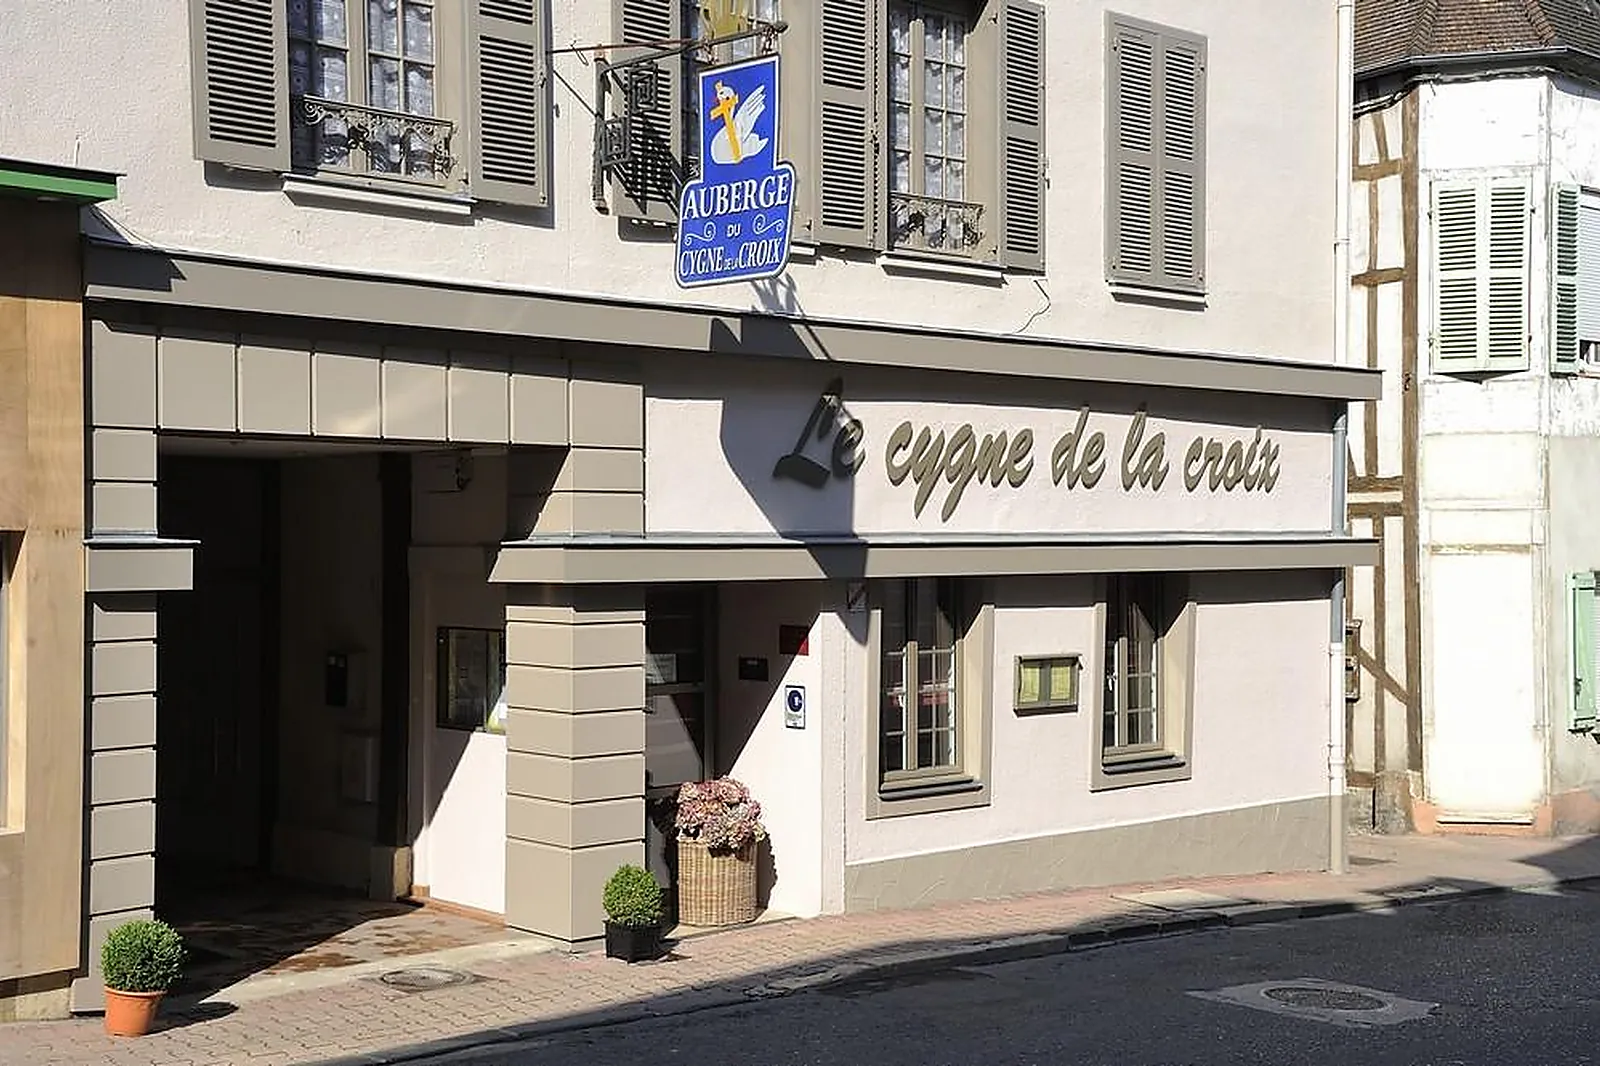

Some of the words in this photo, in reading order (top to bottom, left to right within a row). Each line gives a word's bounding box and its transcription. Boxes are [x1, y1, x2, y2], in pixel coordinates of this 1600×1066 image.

[682, 173, 790, 220] AUBERGE
[727, 223, 741, 237] DU
[680, 246, 725, 276] CYGNE
[738, 237, 783, 268] CROIX
[772, 377, 867, 489] Le
[885, 420, 1034, 524] cygne
[1051, 402, 1106, 491] de
[1120, 401, 1170, 493] la
[1183, 424, 1281, 494] croix
